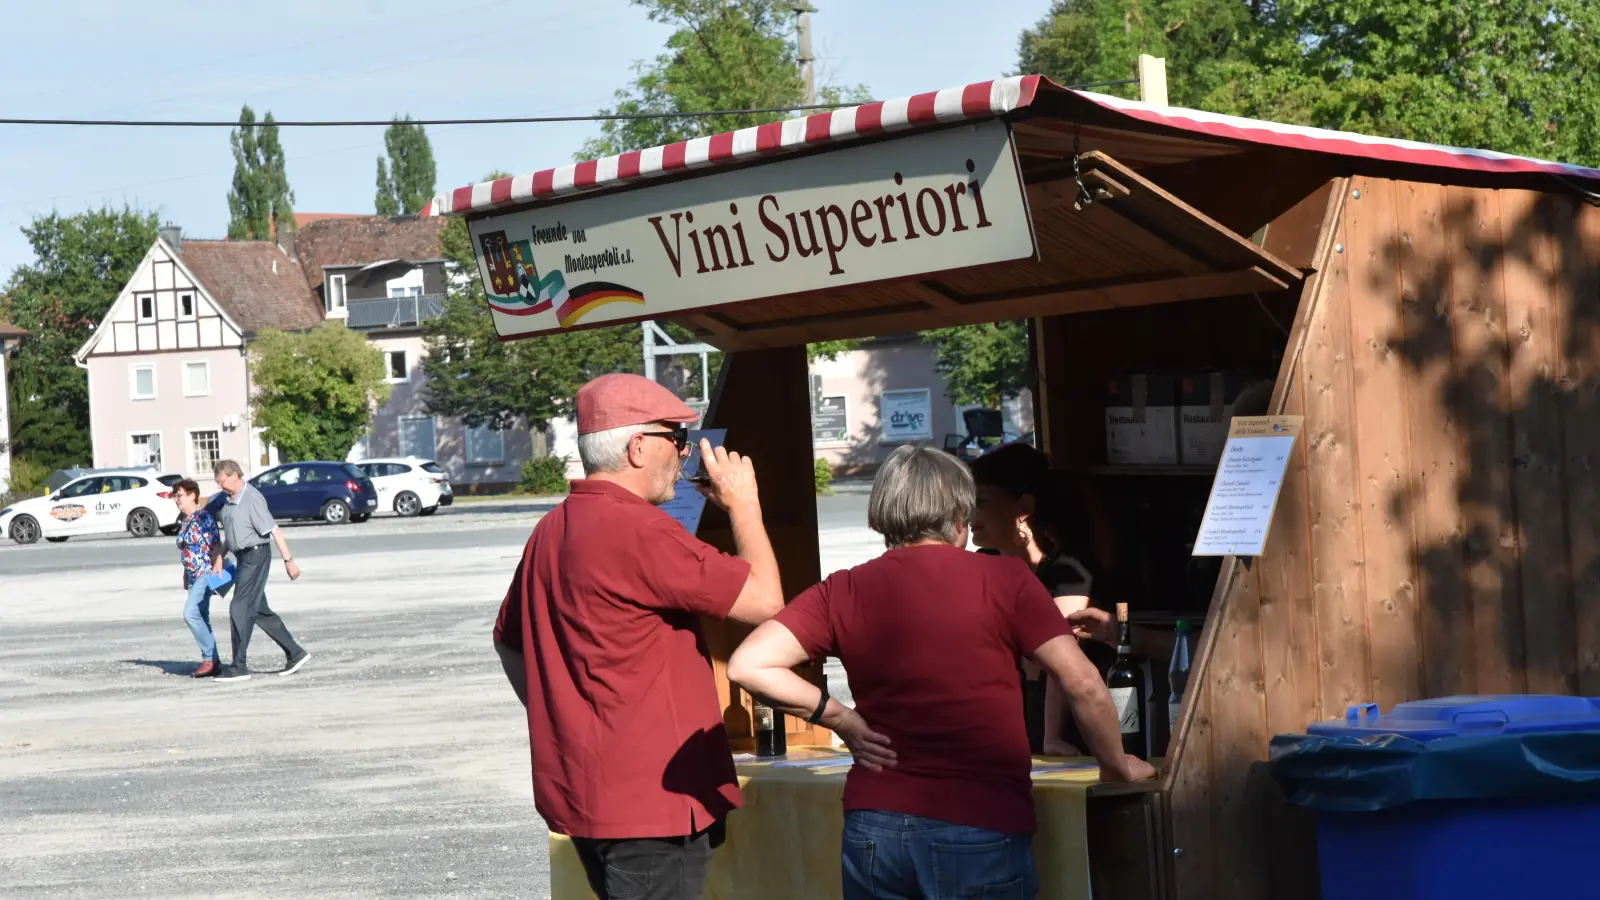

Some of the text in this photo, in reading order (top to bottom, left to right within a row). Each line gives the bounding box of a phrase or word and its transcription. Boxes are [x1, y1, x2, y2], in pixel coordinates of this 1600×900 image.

[648, 158, 993, 278] Vini Superiori
[532, 221, 587, 246] Freunde von
[564, 247, 621, 275] Montespertoli
[95, 501, 121, 511] drve
